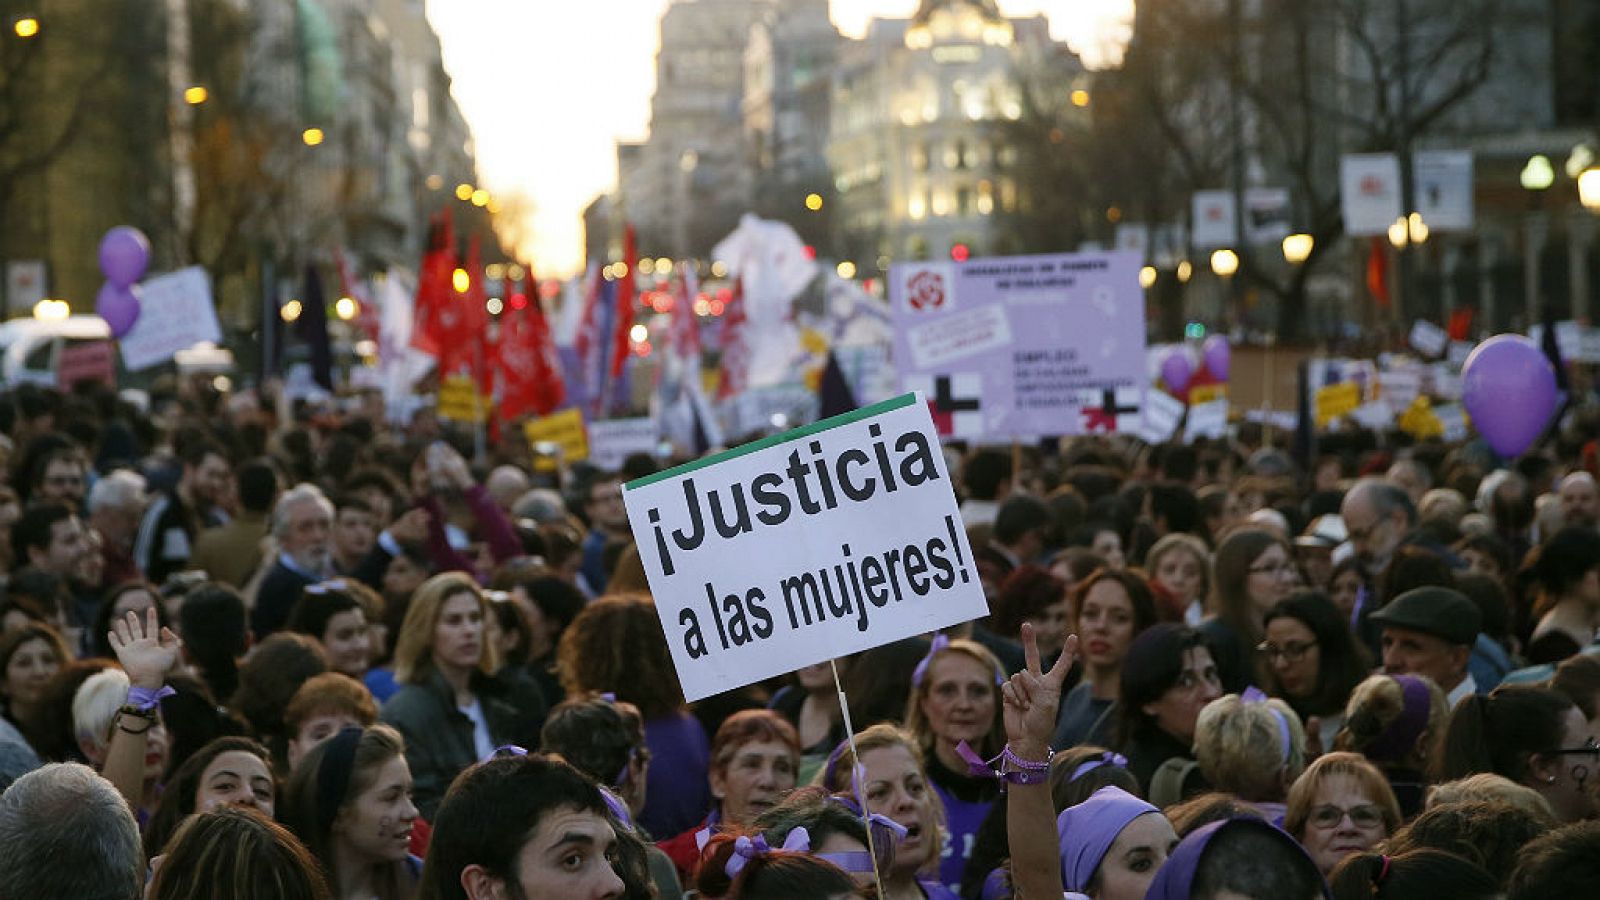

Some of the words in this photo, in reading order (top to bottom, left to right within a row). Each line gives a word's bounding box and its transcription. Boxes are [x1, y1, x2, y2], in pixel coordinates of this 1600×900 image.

[648, 424, 940, 575] ¡Justicia
[679, 606, 708, 659] a
[705, 582, 774, 649] las
[780, 515, 970, 632] mujeres!
